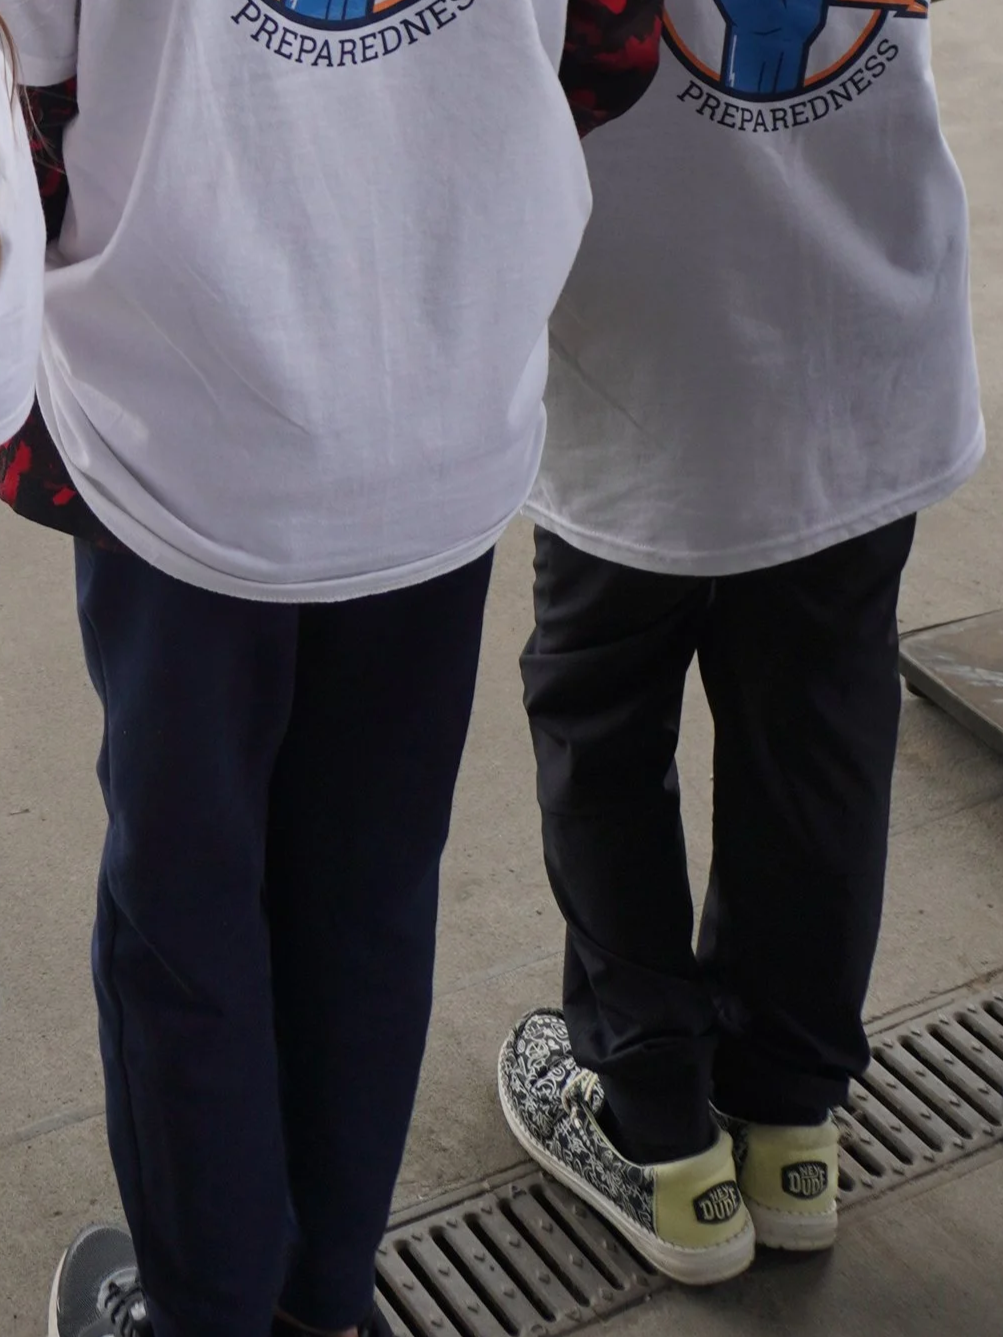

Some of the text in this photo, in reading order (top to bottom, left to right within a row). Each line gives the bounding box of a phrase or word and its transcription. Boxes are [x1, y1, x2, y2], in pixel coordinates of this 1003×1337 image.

[677, 38, 899, 133] PREPAREDNESS
[788, 1170, 825, 1196] DUDE
[700, 1188, 738, 1221] DUDE
